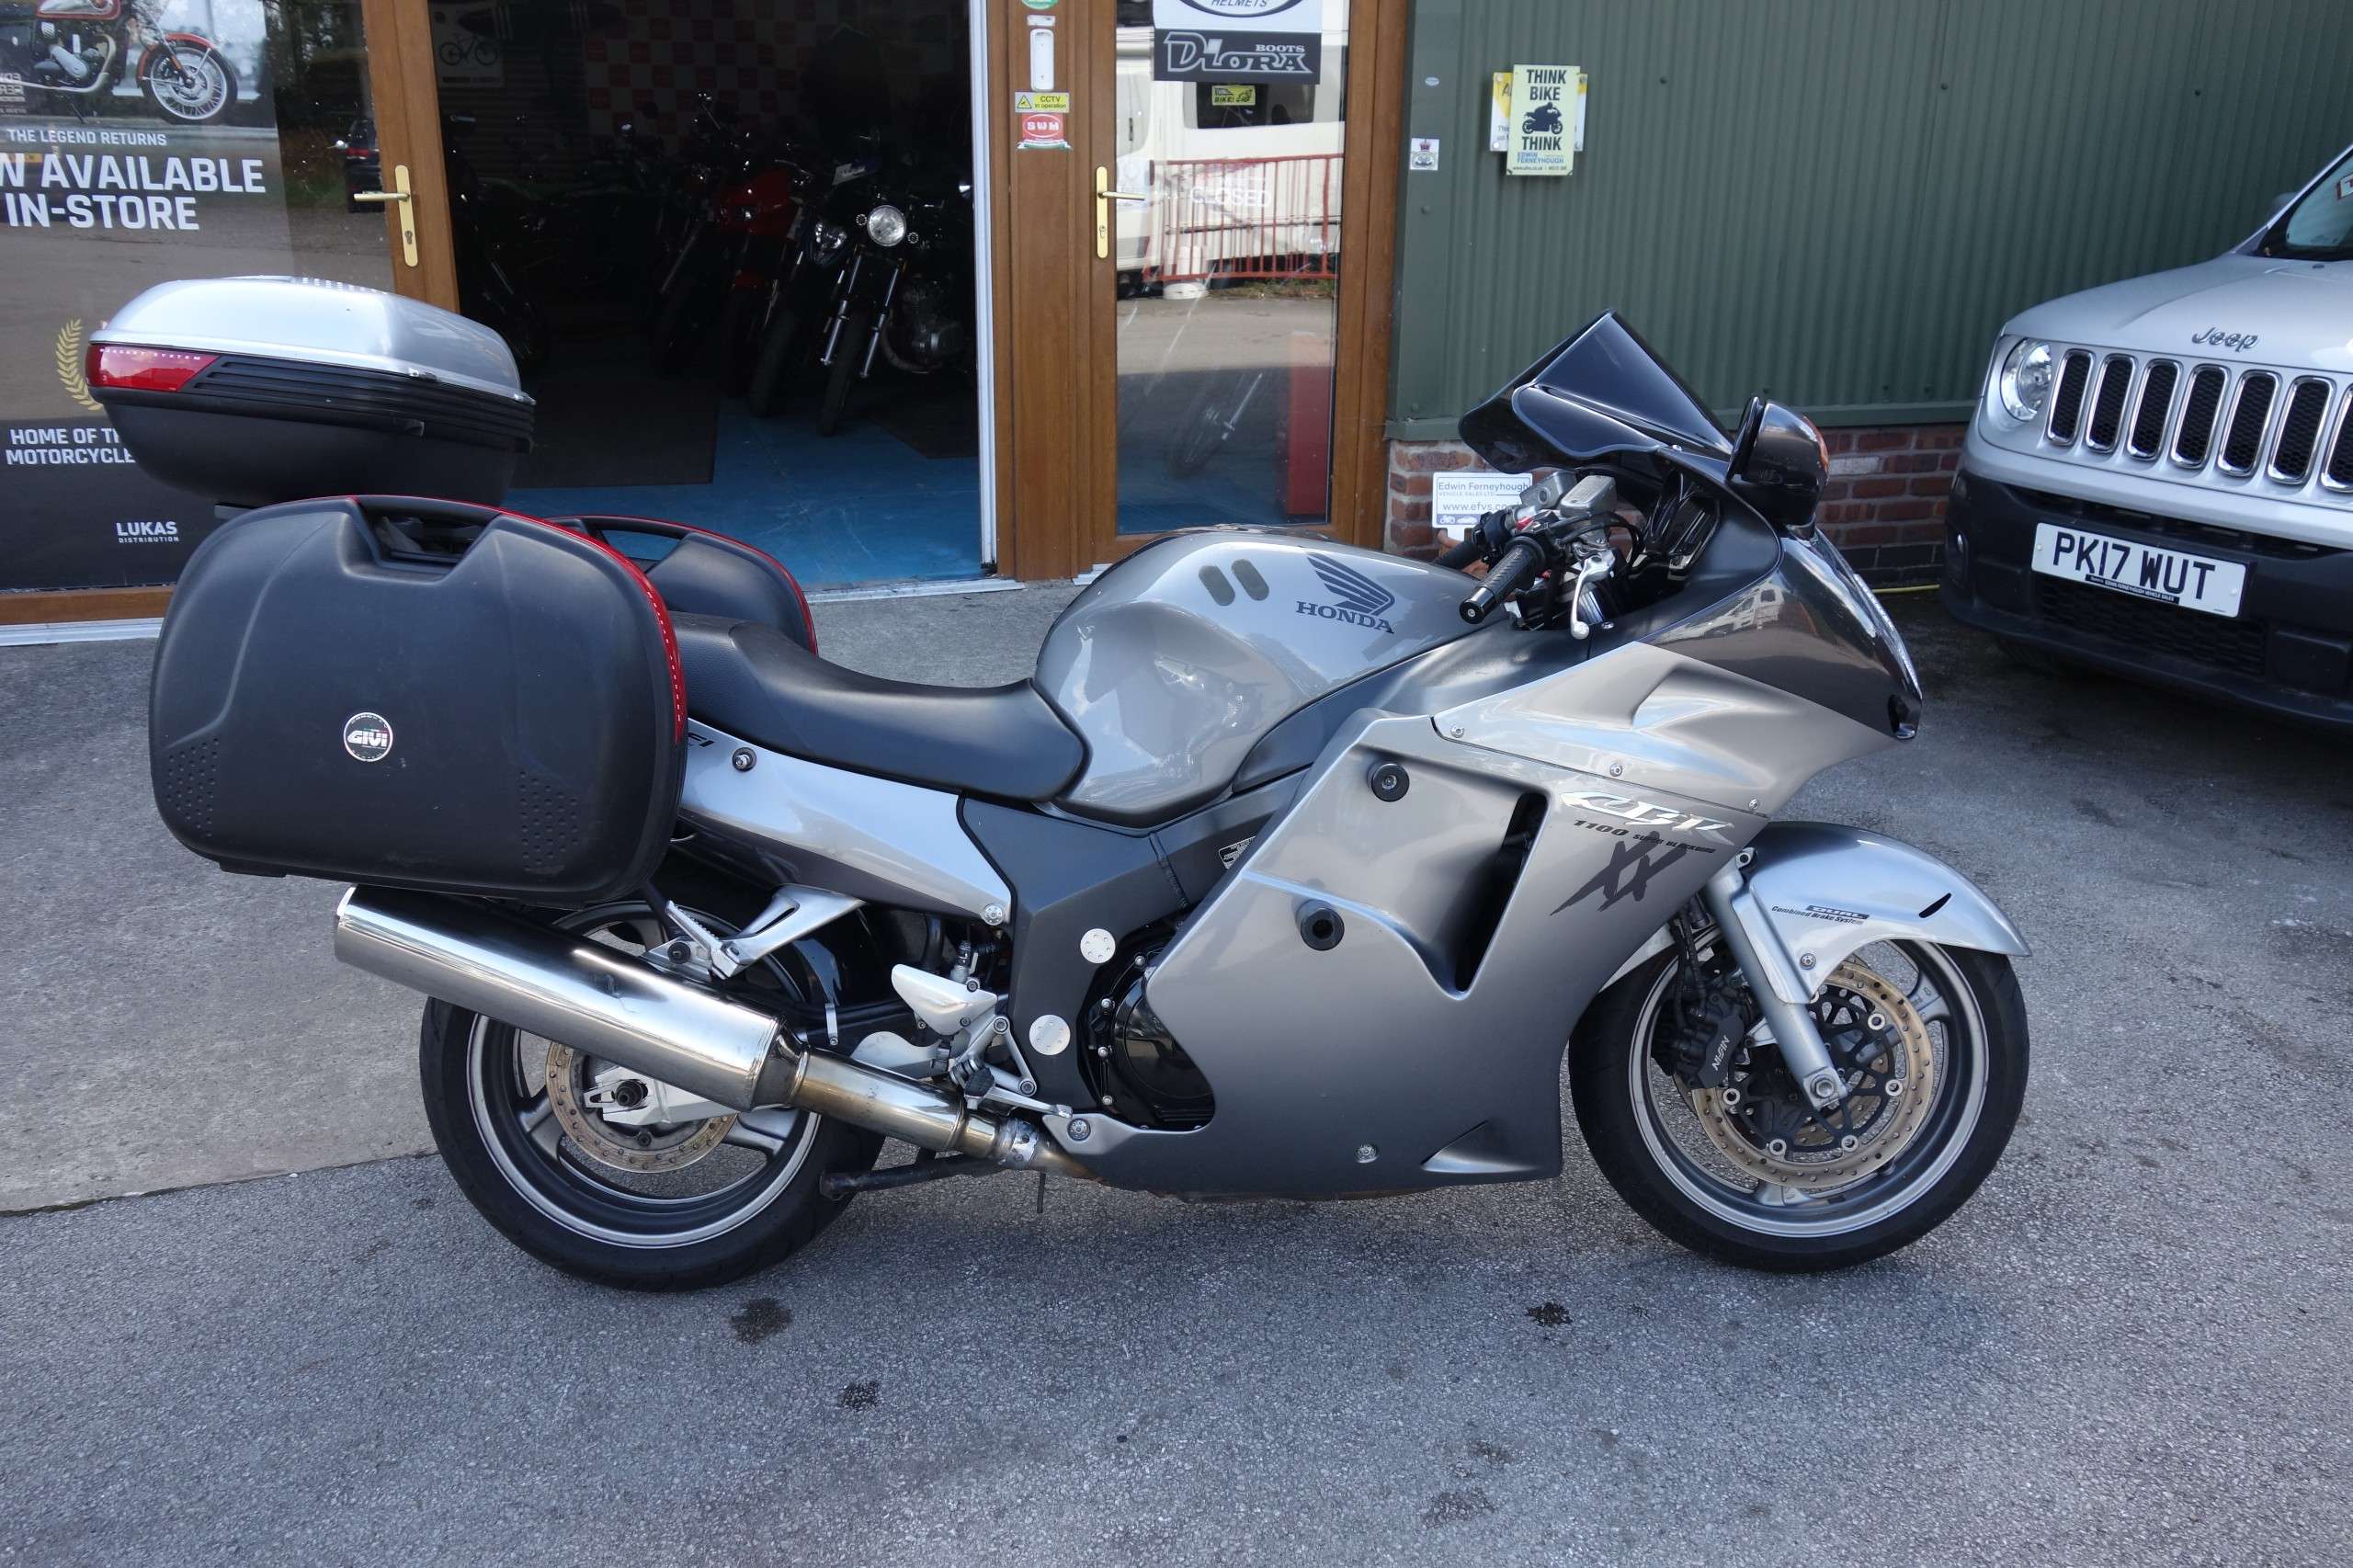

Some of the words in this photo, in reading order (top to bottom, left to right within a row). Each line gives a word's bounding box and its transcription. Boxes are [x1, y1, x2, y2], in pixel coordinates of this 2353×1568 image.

[1256, 44, 1305, 53] BOOTS
[1527, 69, 1567, 85] THINK
[1529, 85, 1561, 101] BIKE
[1027, 121, 1060, 131] SWM
[7, 129, 36, 142] THE
[40, 130, 97, 145] LEGEND
[101, 131, 167, 147] RETURNS
[1521, 136, 1562, 151] THINK
[40, 153, 266, 193] AVAILABLE
[1190, 186, 1271, 208] CLOSED
[5, 192, 200, 231] IN-STORE
[2191, 327, 2258, 352] Jeep
[9, 428, 69, 445] HOME
[73, 428, 97, 444] OF
[1438, 483, 1466, 491] Edwin
[1469, 483, 1529, 493] Ferneyhough
[116, 521, 177, 537] LUKAS
[2052, 531, 2131, 579] PK17
[2139, 550, 2215, 600] WUT
[1296, 600, 1395, 635] HONDA
[1574, 819, 1630, 836] 1100
[1550, 830, 1688, 916] XX
[1771, 905, 1812, 917] Combined
[1811, 913, 1836, 921] Brake
[1835, 915, 1864, 926] System
